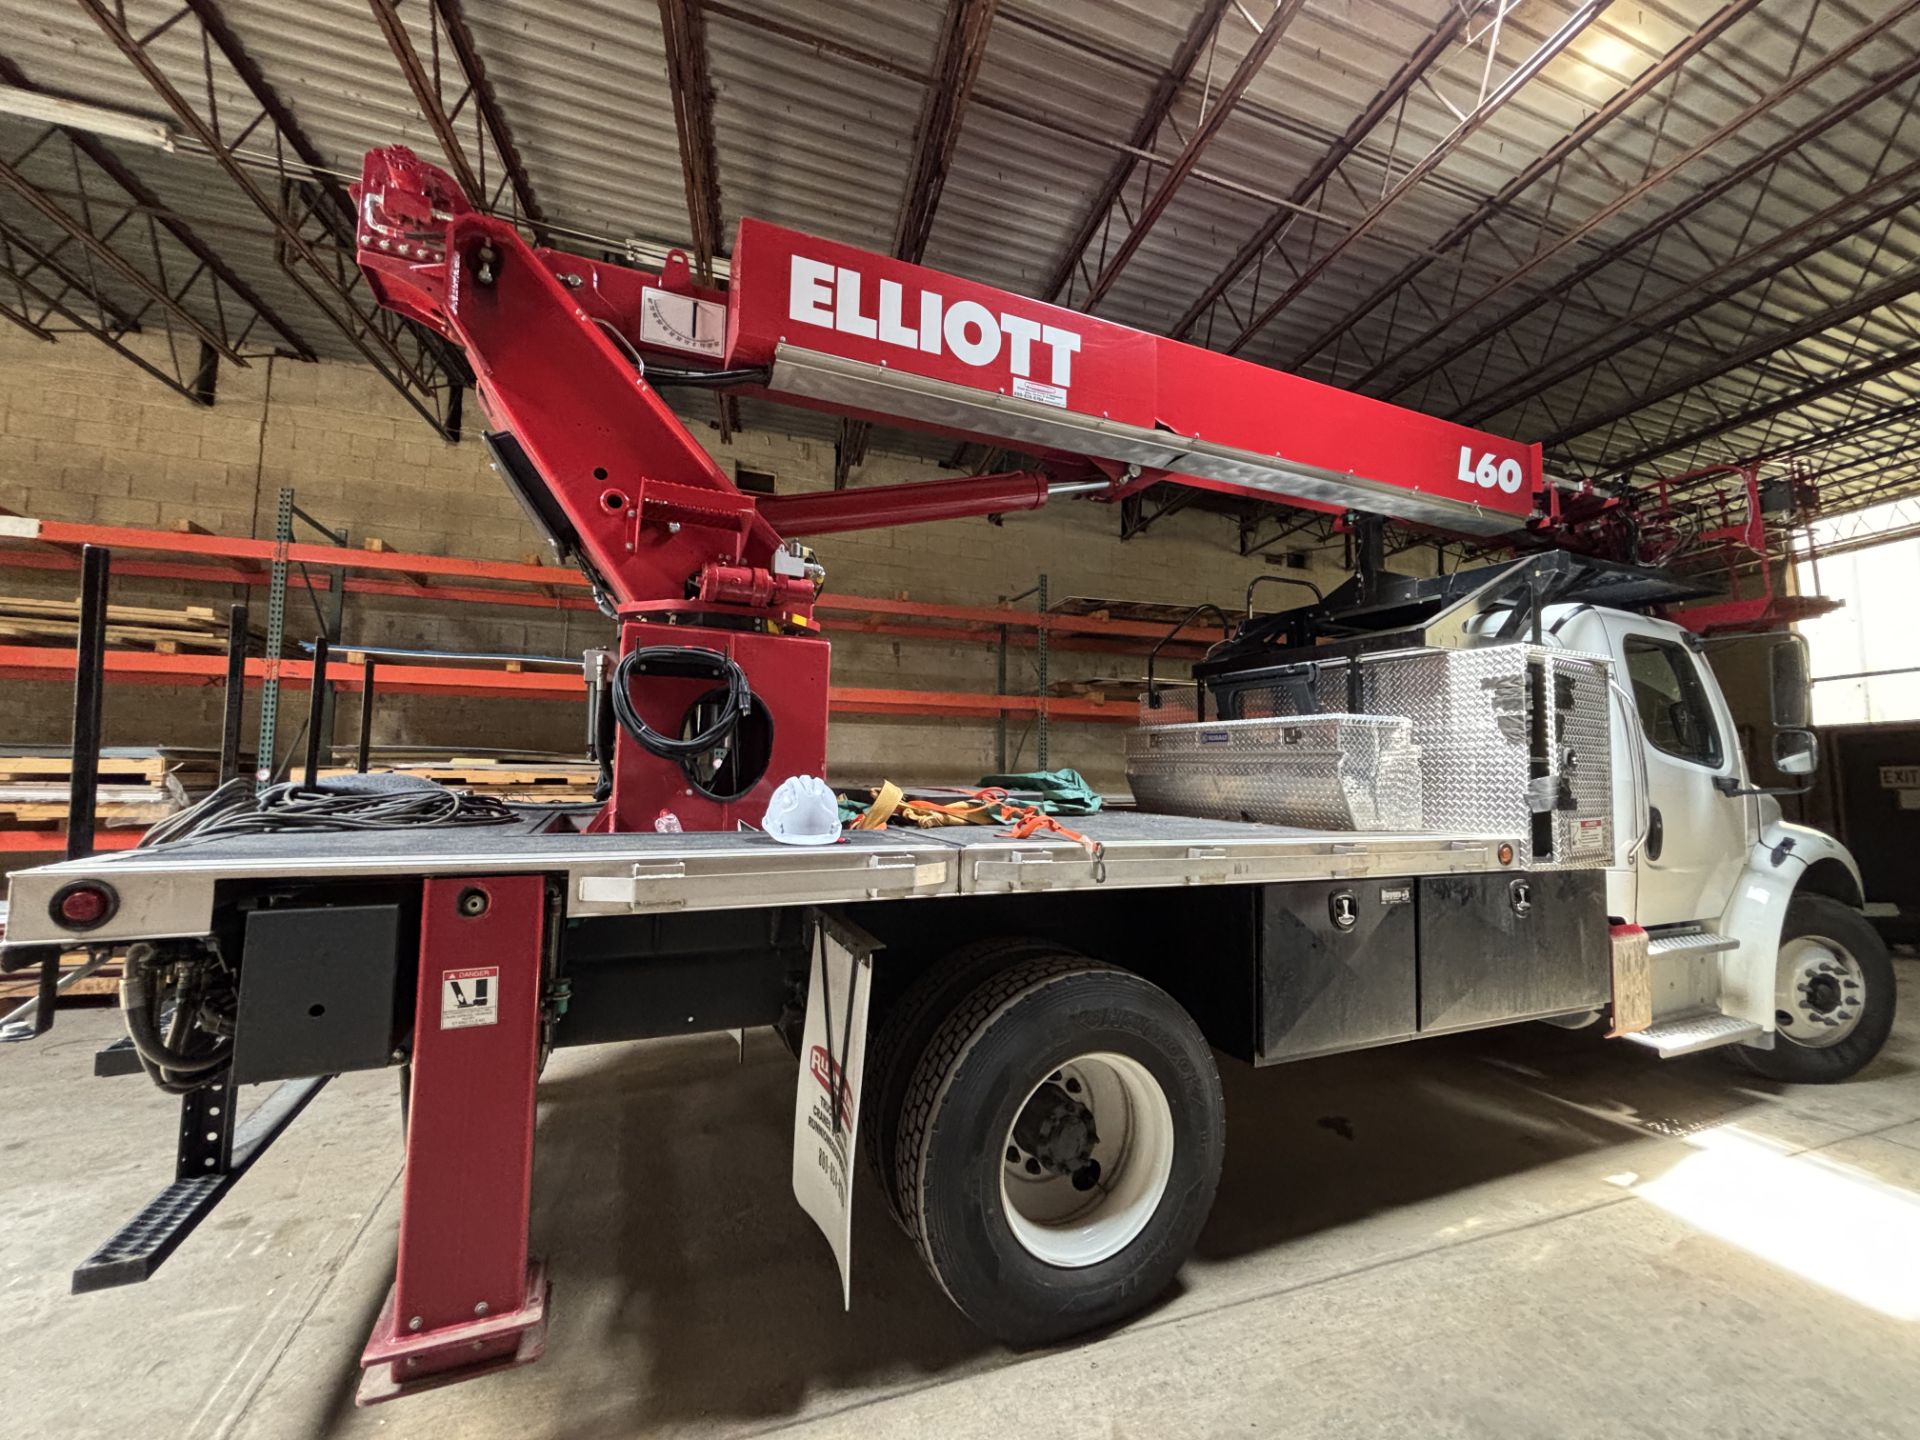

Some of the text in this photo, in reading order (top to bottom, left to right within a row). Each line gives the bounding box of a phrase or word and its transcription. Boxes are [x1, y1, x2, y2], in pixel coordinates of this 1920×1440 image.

[789, 254, 1081, 387] ELLIOTT
[1458, 445, 1522, 494] L60
[1883, 769, 1918, 784] EXIT
[458, 969, 490, 979] DANGER
